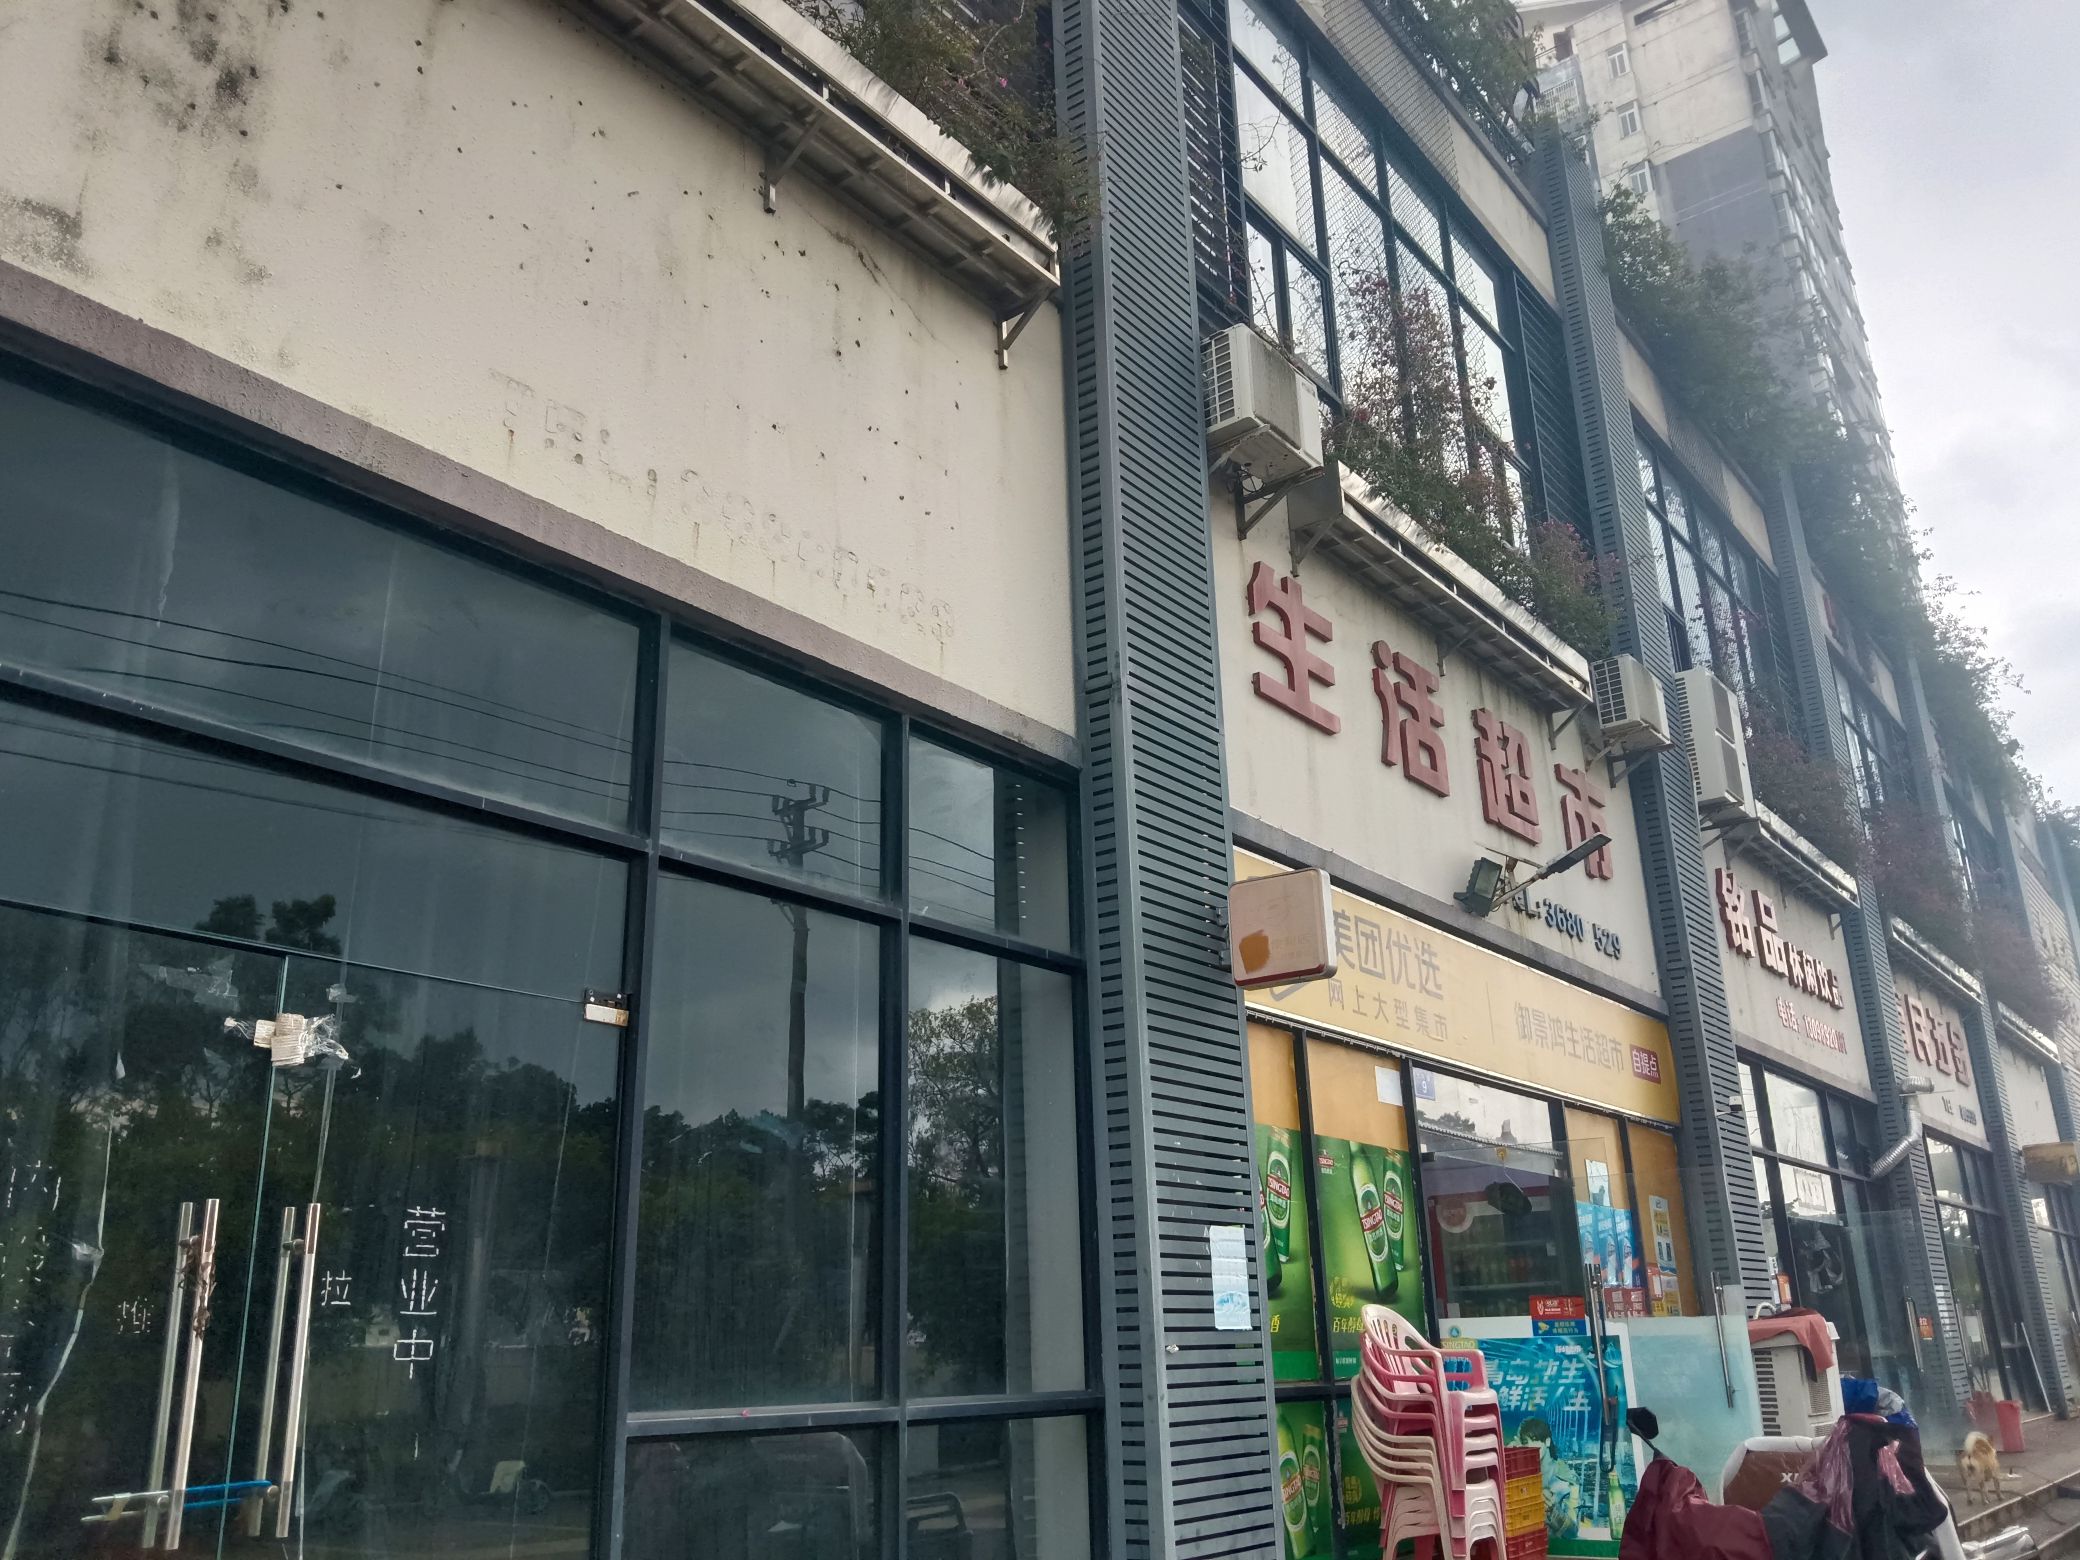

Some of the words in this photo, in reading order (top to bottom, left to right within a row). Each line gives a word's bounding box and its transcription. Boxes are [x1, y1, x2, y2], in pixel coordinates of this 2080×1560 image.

[1247, 561, 1613, 880] 生活超市
[1332, 909, 1444, 1000] 美团优选
[1543, 898, 1584, 943] 3680
[1592, 922, 1622, 960] 529
[1328, 978, 1448, 1041] 网上大型集市
[1514, 1001, 1624, 1073] 御景鸿生活超市
[1632, 1048, 1659, 1078] 自提点
[1421, 1080, 1428, 1094] 9
[1361, 1209, 1383, 1229] TSINGTAO
[321, 1269, 352, 1307] 拉
[393, 1205, 446, 1380] 营业中
